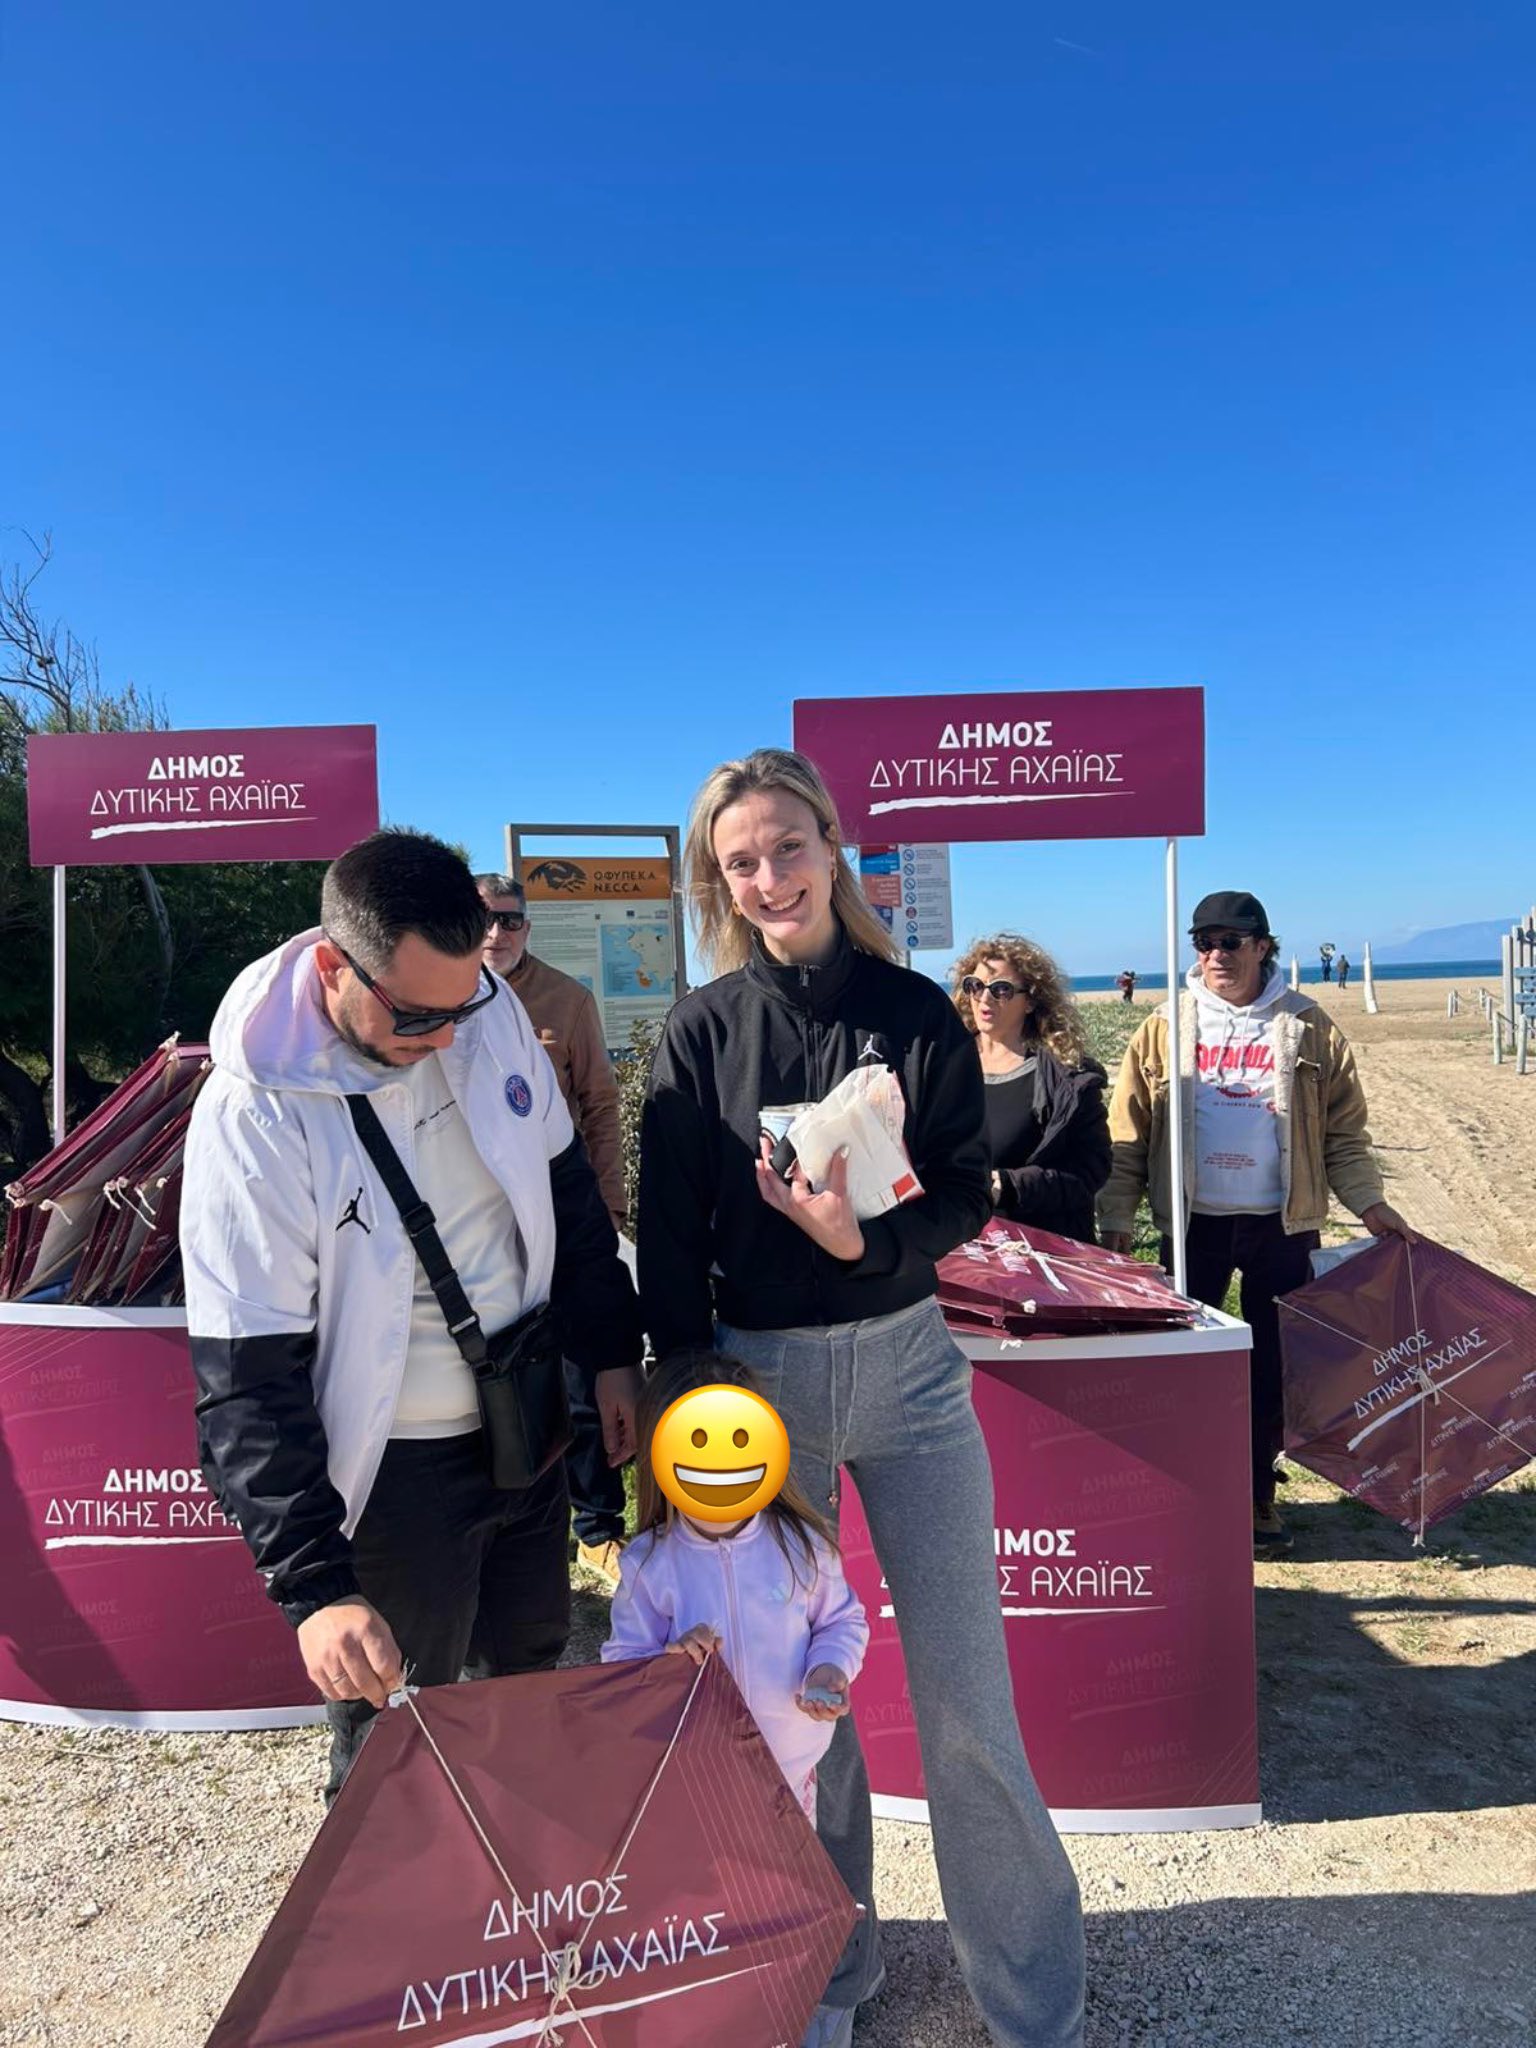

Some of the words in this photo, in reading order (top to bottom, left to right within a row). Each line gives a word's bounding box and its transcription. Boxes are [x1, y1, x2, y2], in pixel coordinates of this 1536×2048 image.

[938, 721, 1053, 749] ΔΗΜΟΣ
[147, 755, 245, 780] ΔΗΜΟΣ
[870, 757, 999, 788] ΔΥΤΙΚΗΣ
[1010, 749, 1124, 784] ΑΧΑΪΑΣ
[90, 786, 201, 815] ΔΥΤΙΚΗΣ
[209, 780, 306, 812] ΑΧΑΪΑΣ
[593, 870, 656, 881] ΟΦΥΠΕΚΑ
[593, 882, 641, 893] NECCA
[1373, 1329, 1432, 1375] ΔΗΜΟΣ
[1425, 1327, 1488, 1374] ΑΧΑΪΑΣ
[103, 1468, 209, 1492] ΔΗΜΟΣ
[45, 1498, 160, 1527] ΔΥΤΙΚΗΣ
[168, 1500, 242, 1531] ΑΧΑ
[993, 1528, 1077, 1556] ΜΟΣ
[1031, 1560, 1153, 1597] ΑΧΑΪΑΣ
[484, 1873, 628, 1941] ΔΗΜΟΣ
[590, 1911, 730, 1978] ΑΧΑΪΑΣ
